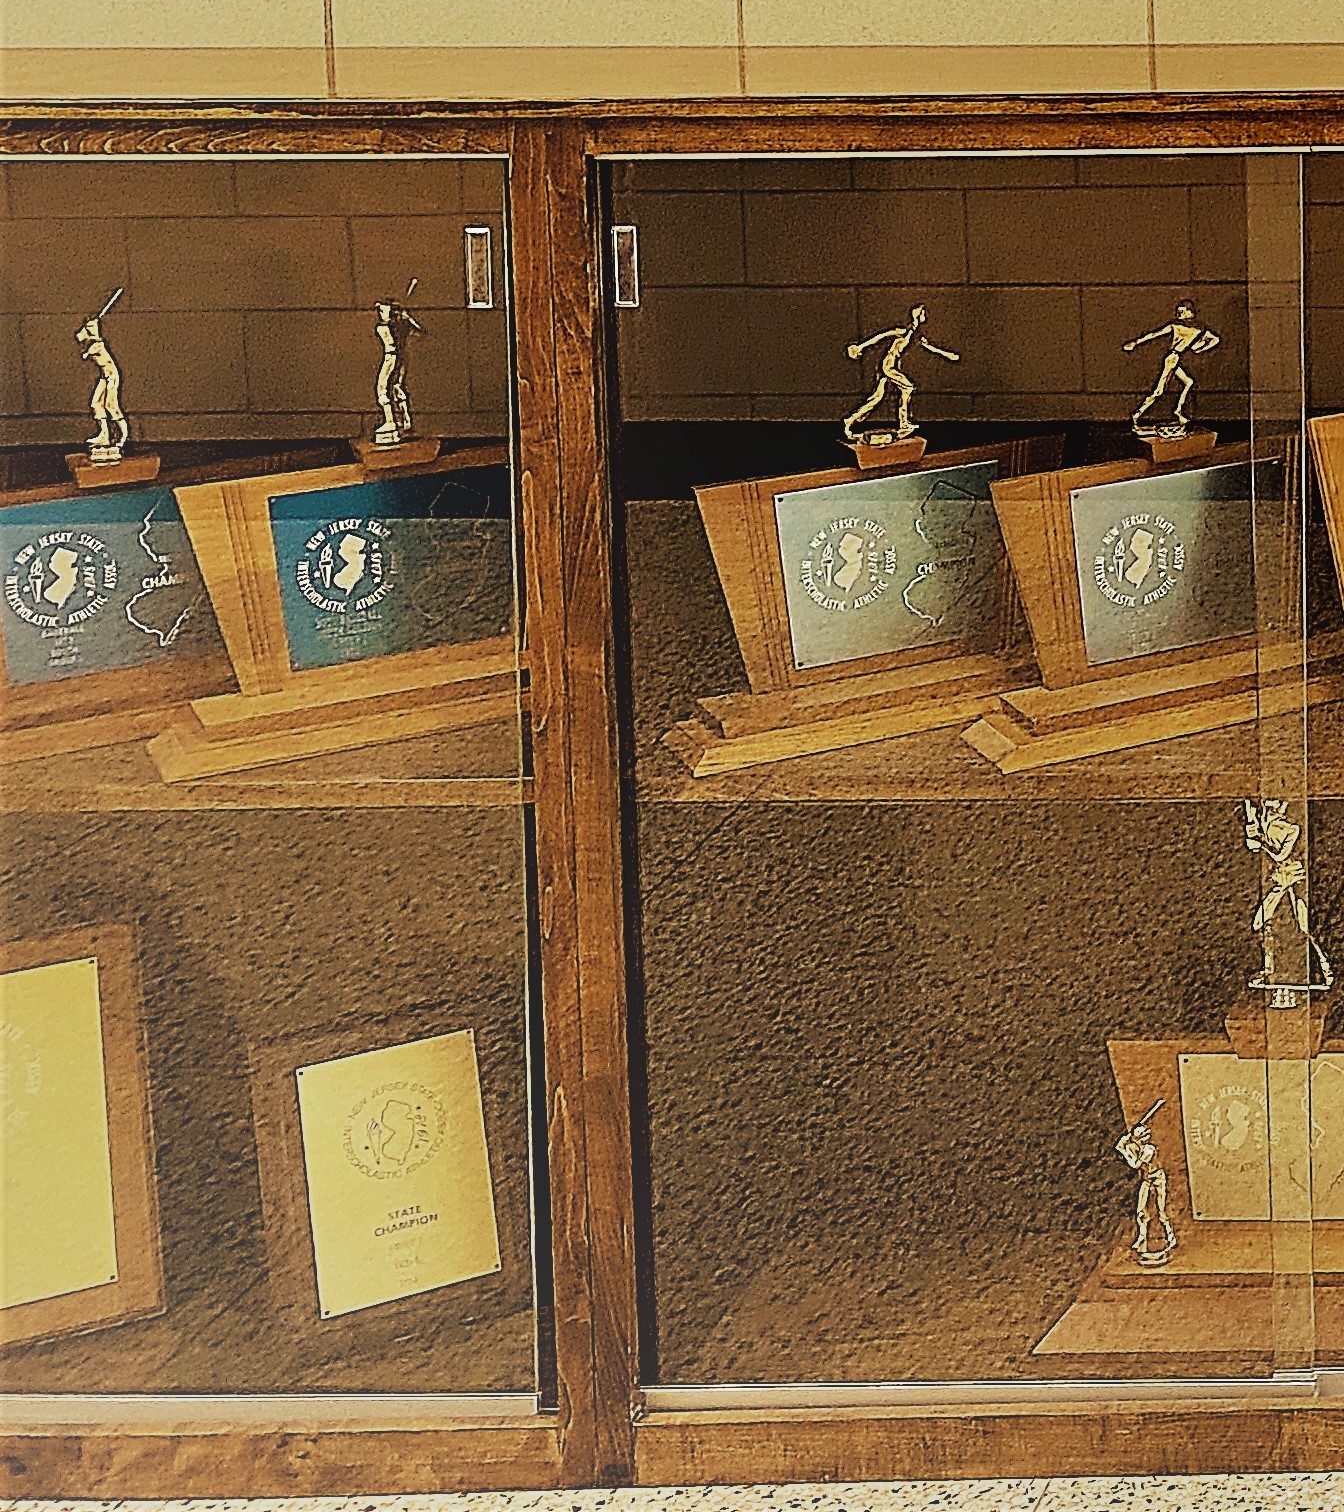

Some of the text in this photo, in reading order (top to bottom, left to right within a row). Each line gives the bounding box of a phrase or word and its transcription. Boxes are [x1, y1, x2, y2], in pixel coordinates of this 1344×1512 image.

[305, 519, 392, 551] NEW JERSEY STATE
[828, 517, 859, 533] JERSEY
[863, 519, 886, 538] STATE
[1153, 515, 1176, 535] STATE
[38, 532, 73, 549] JERSEY
[78, 533, 106, 553] STATE
[5, 575, 59, 627] INTERSCHOLASTIC
[67, 594, 108, 625] ATHLETIC
[355, 582, 394, 611] ATHLETIC
[853, 580, 889, 609] ATHLETIC
[1143, 576, 1177, 605] ATHLETIC
[374, 1213, 439, 1237] CHAMPION
[388, 1205, 422, 1220] STATE
